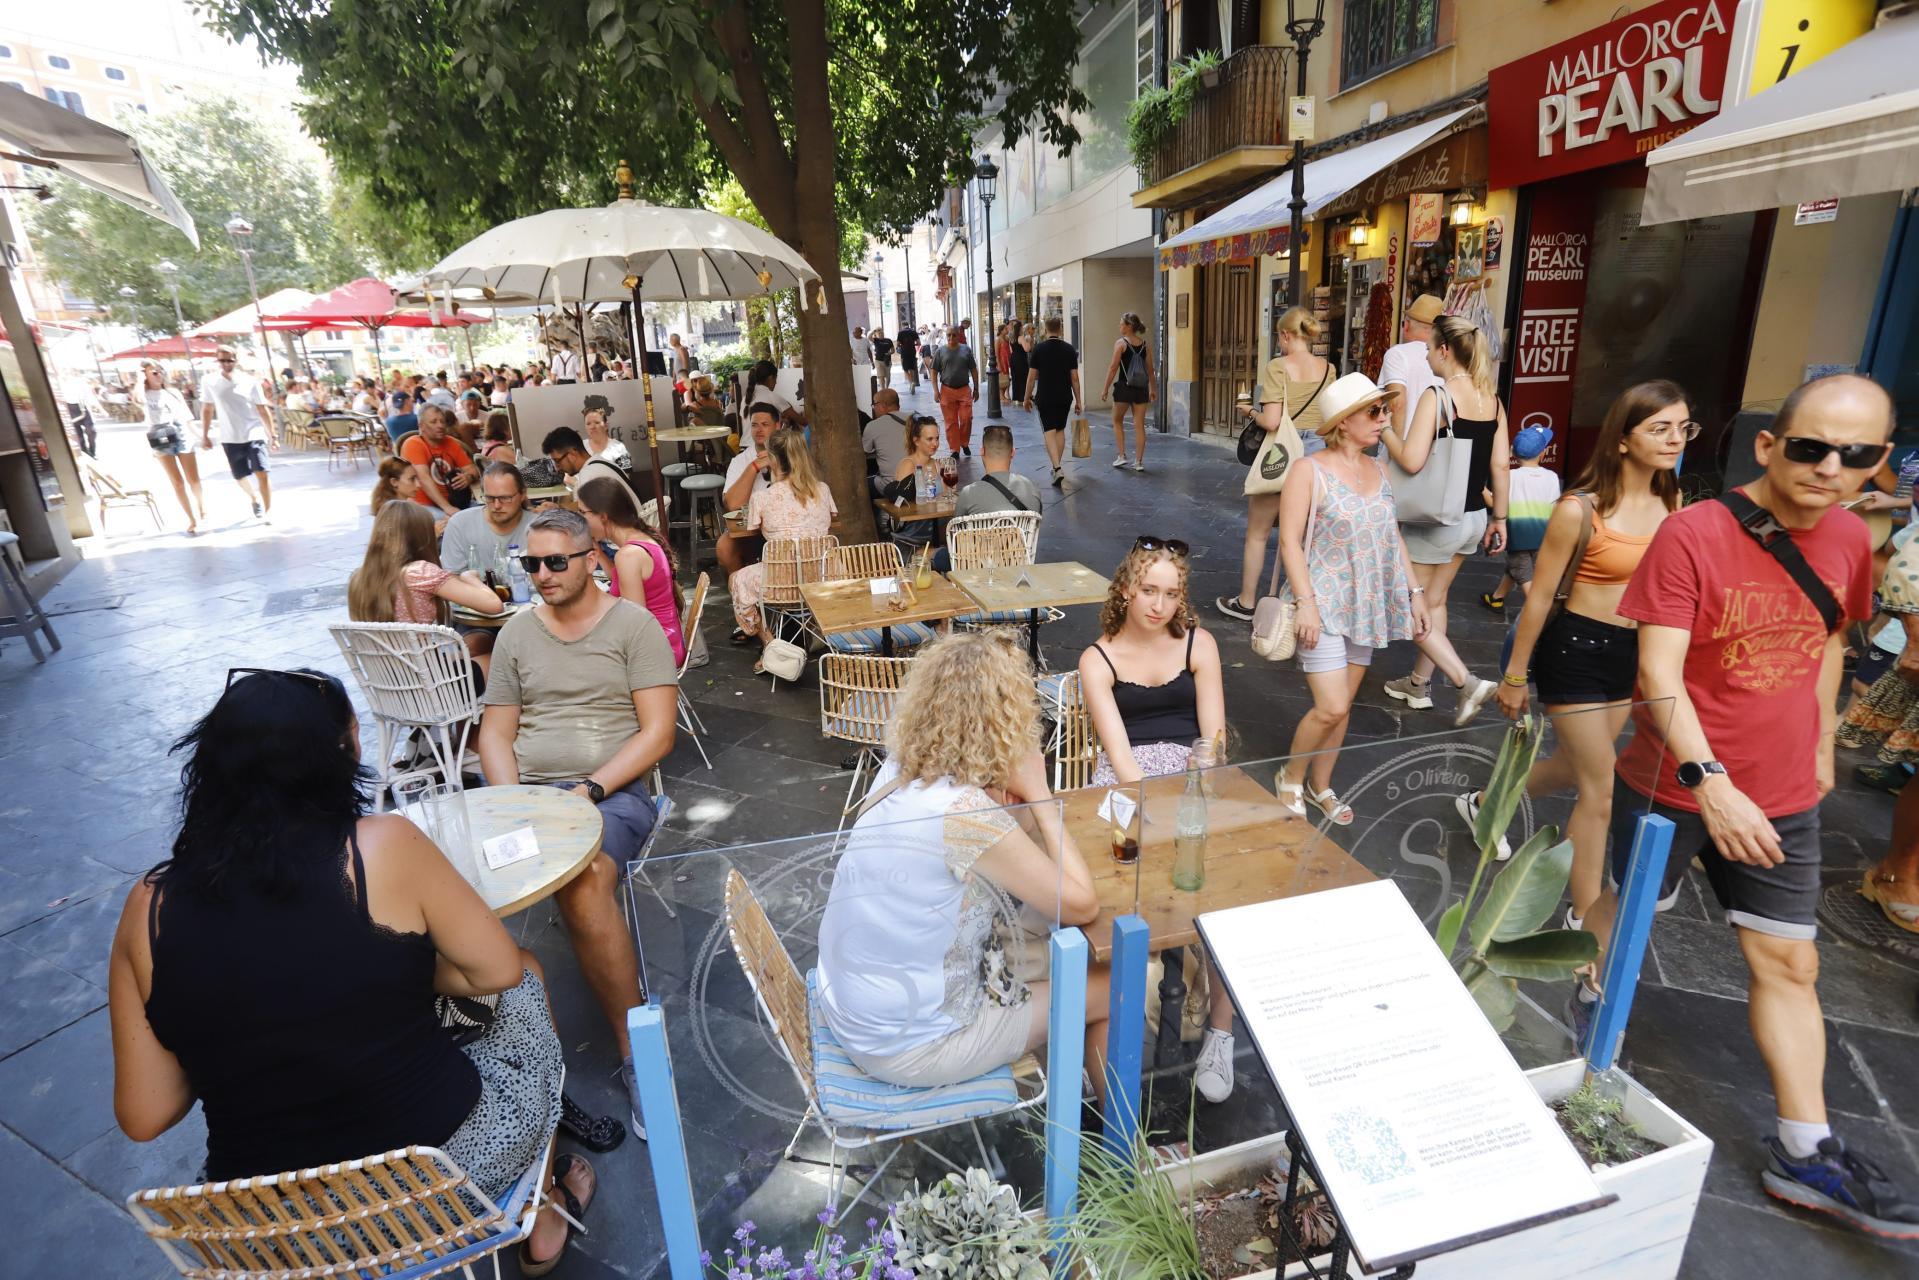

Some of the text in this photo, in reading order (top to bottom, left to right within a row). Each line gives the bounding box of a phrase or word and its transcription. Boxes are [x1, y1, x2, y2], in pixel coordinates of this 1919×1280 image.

[1545, 0, 1726, 95] MALLORCA
[1538, 45, 1719, 158] PEARL
[1530, 231, 1587, 246] MALLORCA
[1527, 247, 1584, 269] PEARL
[1526, 269, 1583, 282] museum
[1520, 318, 1578, 346] FREE
[1519, 346, 1574, 374] VISIT
[1712, 587, 1774, 639] JACK
